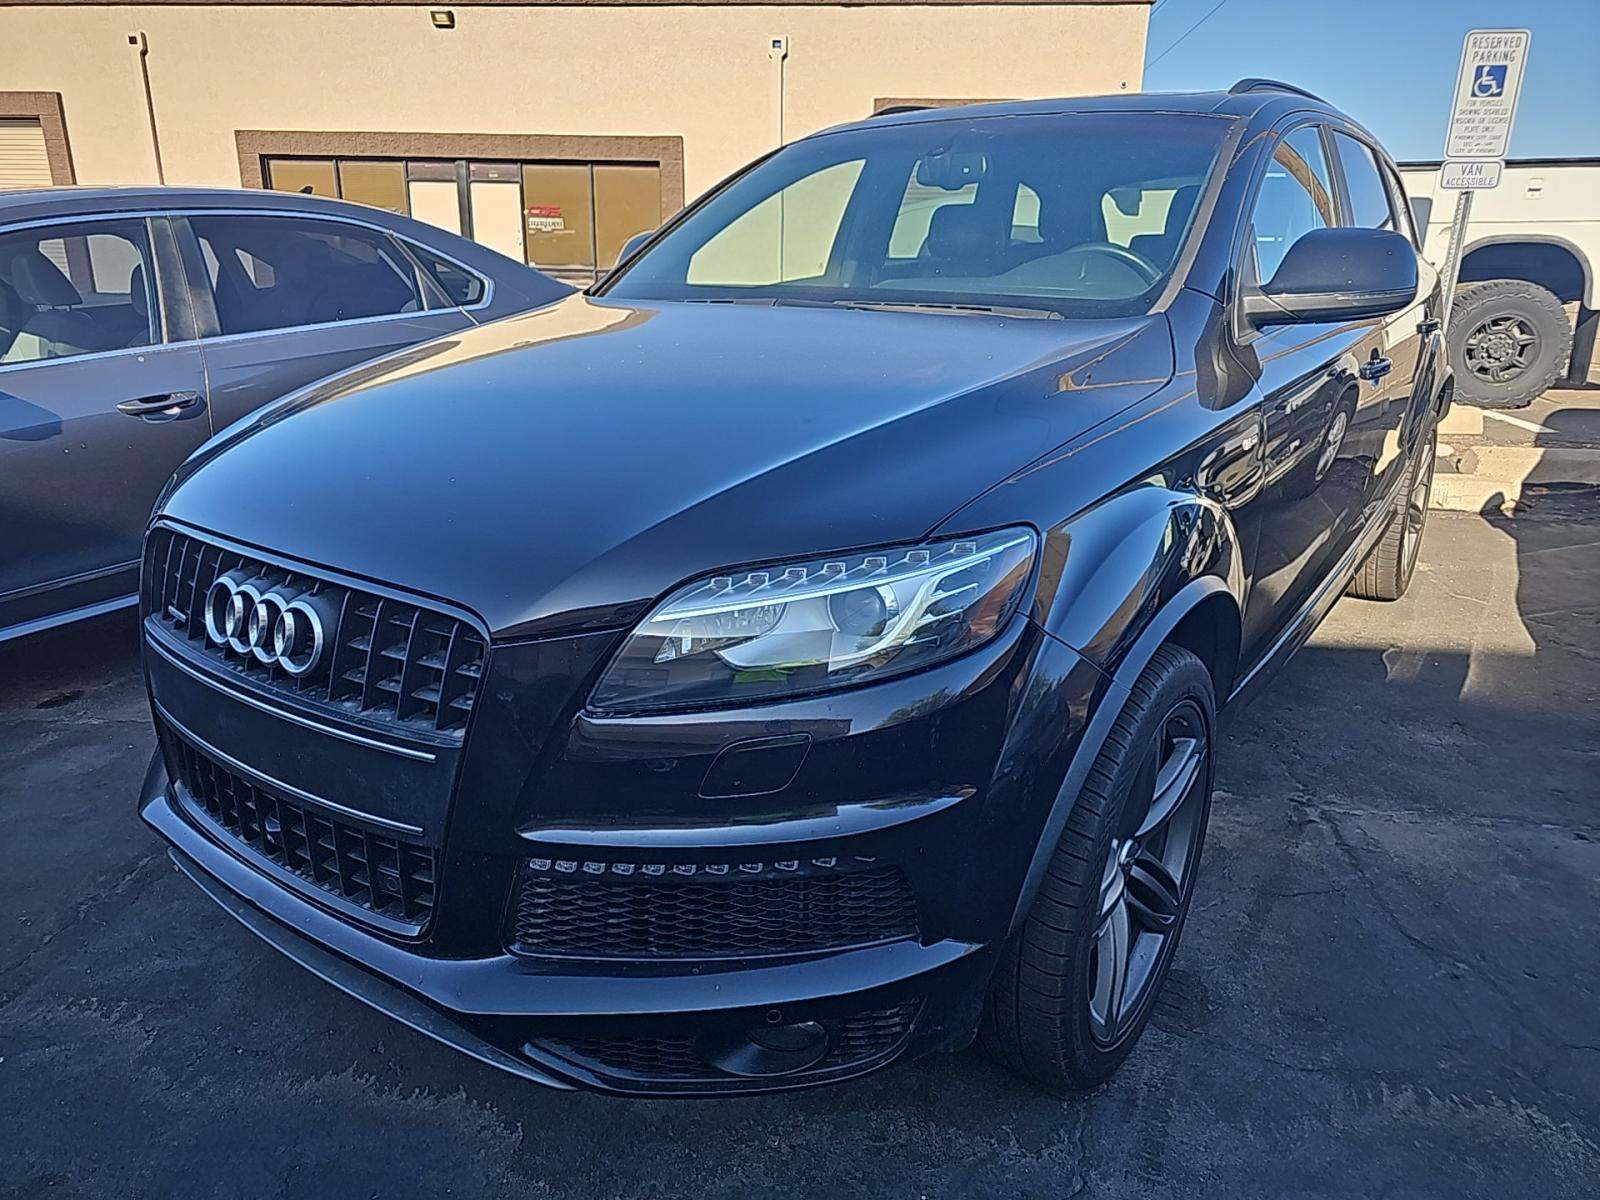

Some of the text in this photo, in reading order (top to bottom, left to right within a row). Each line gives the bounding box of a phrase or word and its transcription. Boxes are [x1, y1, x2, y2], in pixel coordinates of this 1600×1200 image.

[1472, 36, 1522, 49] RESERVED
[1472, 50, 1516, 63] PARKING
[1461, 164, 1484, 176] VAN
[1445, 176, 1496, 186] ACCESSIBLE
